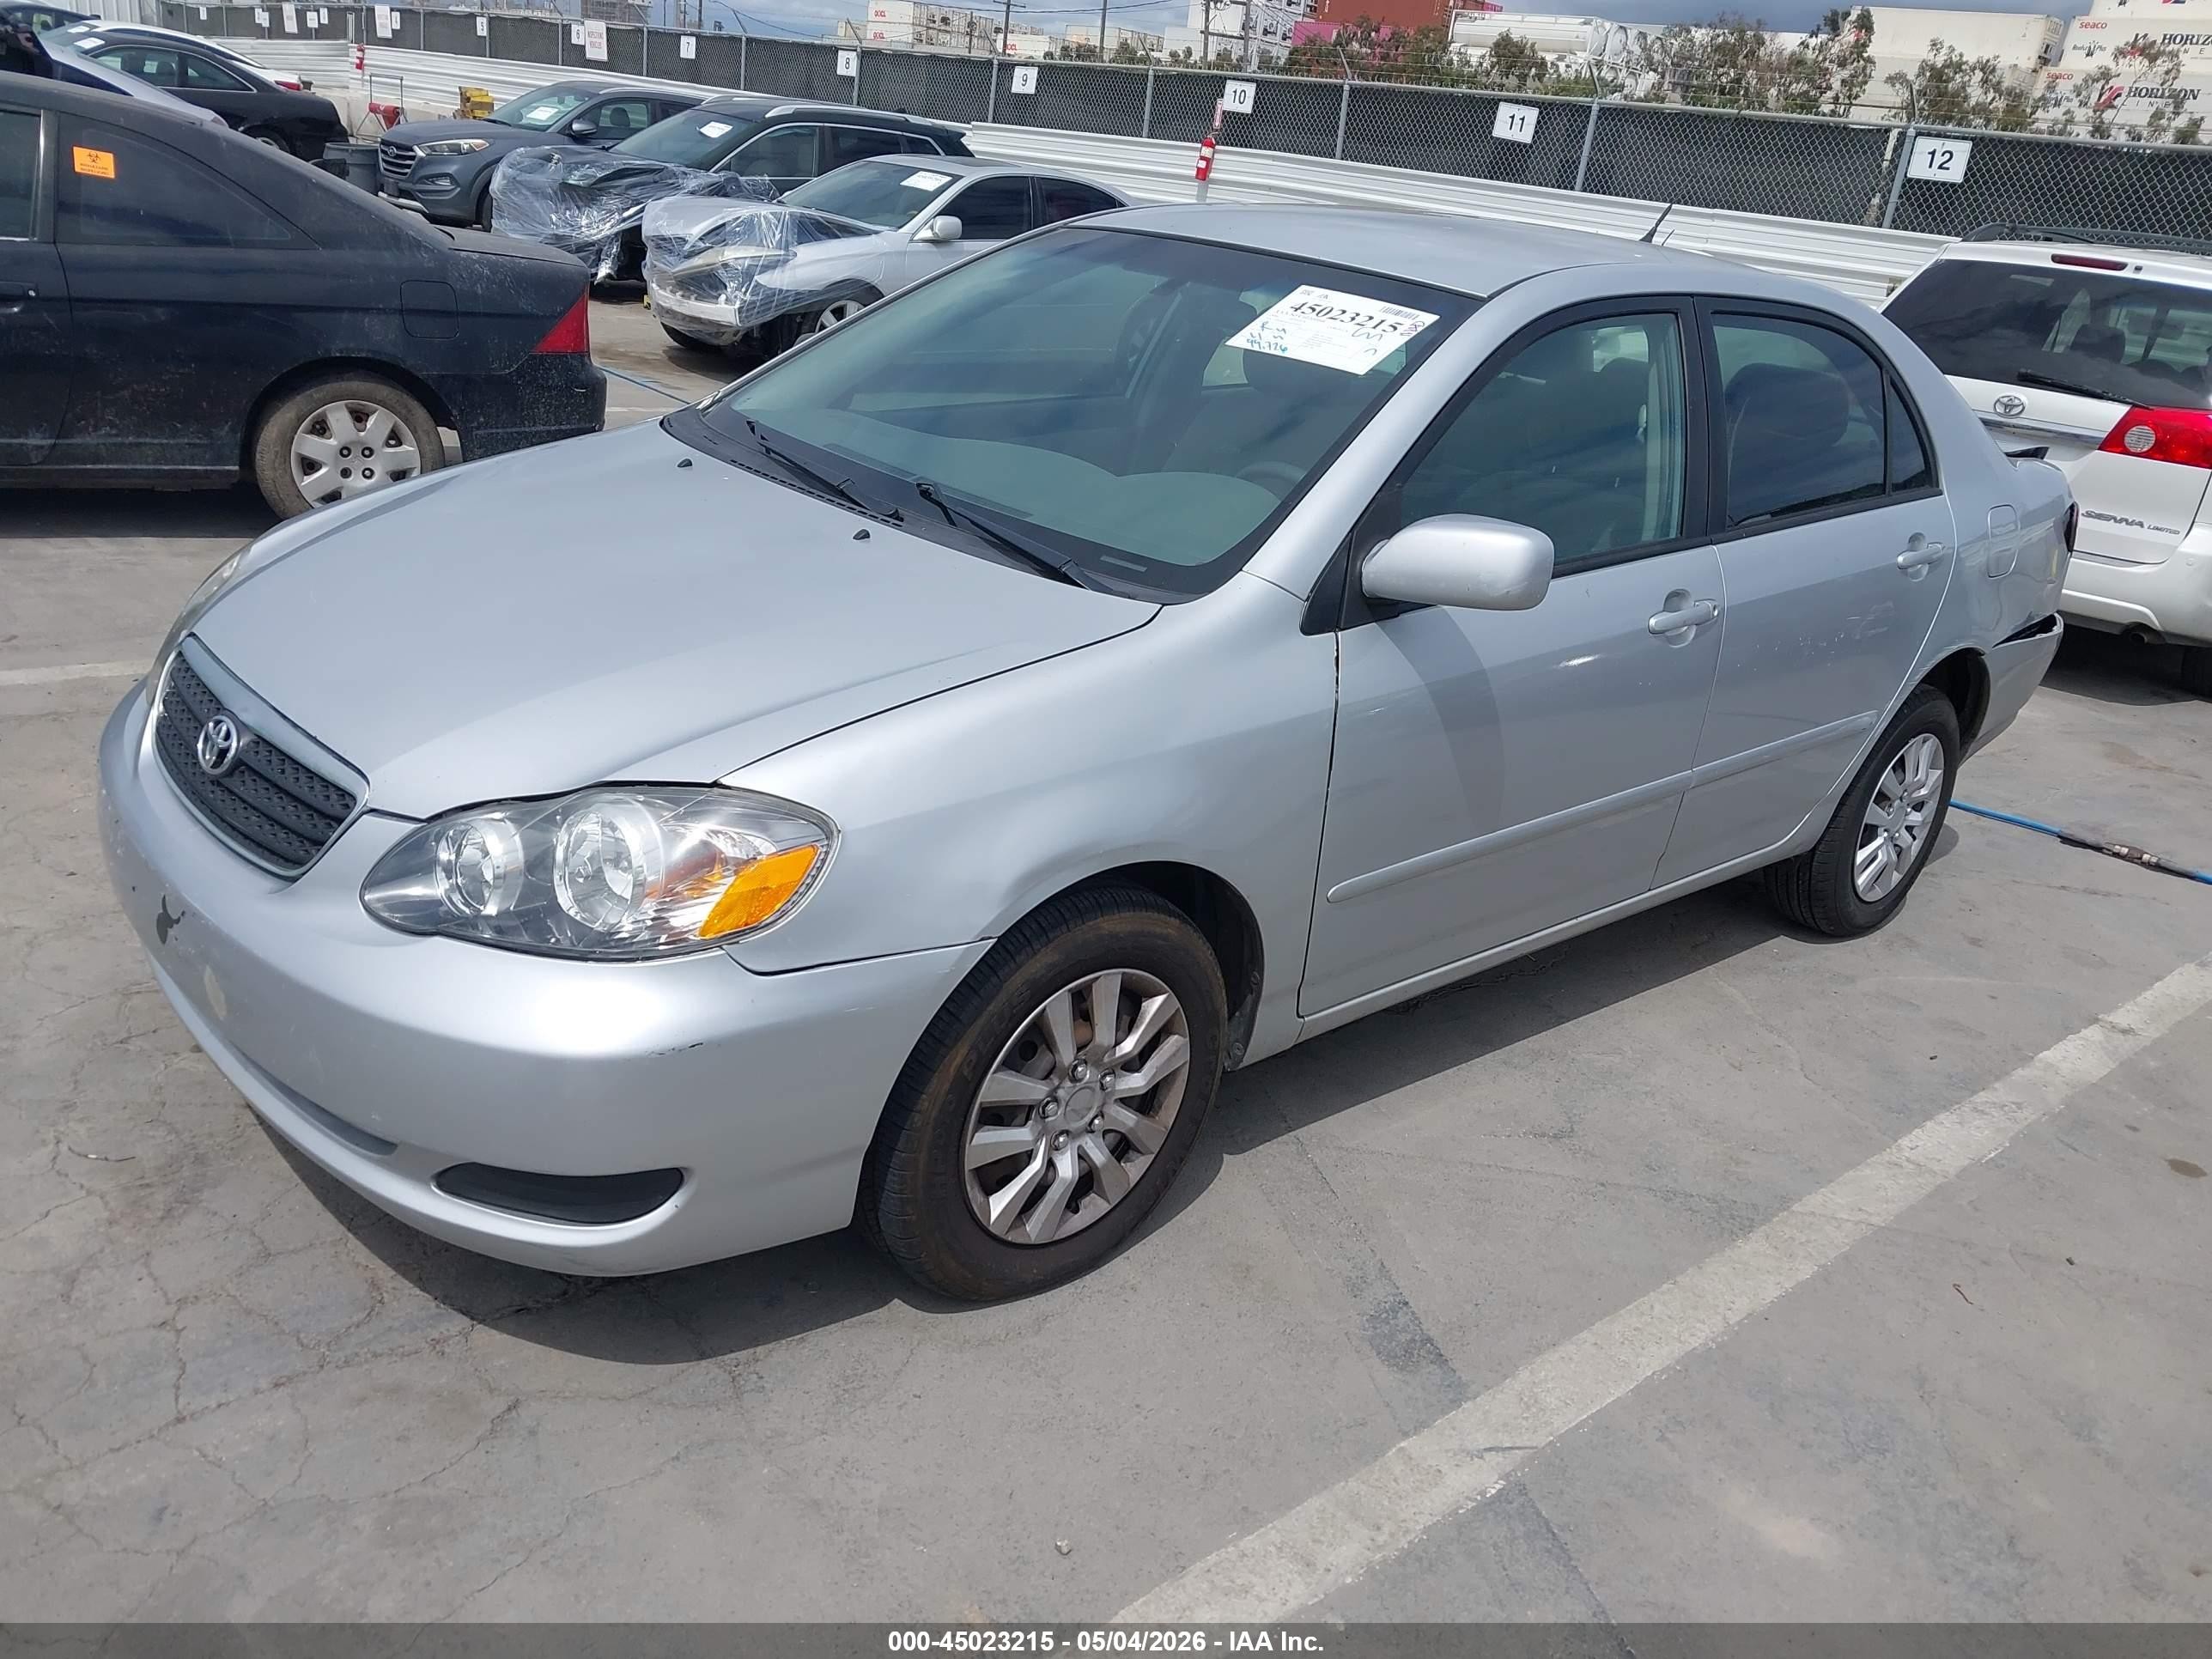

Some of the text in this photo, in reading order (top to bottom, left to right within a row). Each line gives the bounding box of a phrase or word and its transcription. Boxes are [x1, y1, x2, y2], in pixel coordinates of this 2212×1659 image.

[575, 28, 580, 40] 6
[2160, 33, 2212, 46] HORIZ
[686, 41, 690, 53] 7
[844, 57, 850, 70] 8
[1021, 73, 1028, 87] 9
[2046, 72, 2074, 81] seaco
[1232, 88, 1247, 105] 10
[2126, 86, 2201, 100] HORIZON
[2123, 100, 2172, 109] LINE
[1509, 113, 1525, 133] 11
[1927, 148, 1954, 171] 12
[1291, 302, 1404, 332] 45023215
[2081, 510, 2181, 536] SIENNA LIMITED
